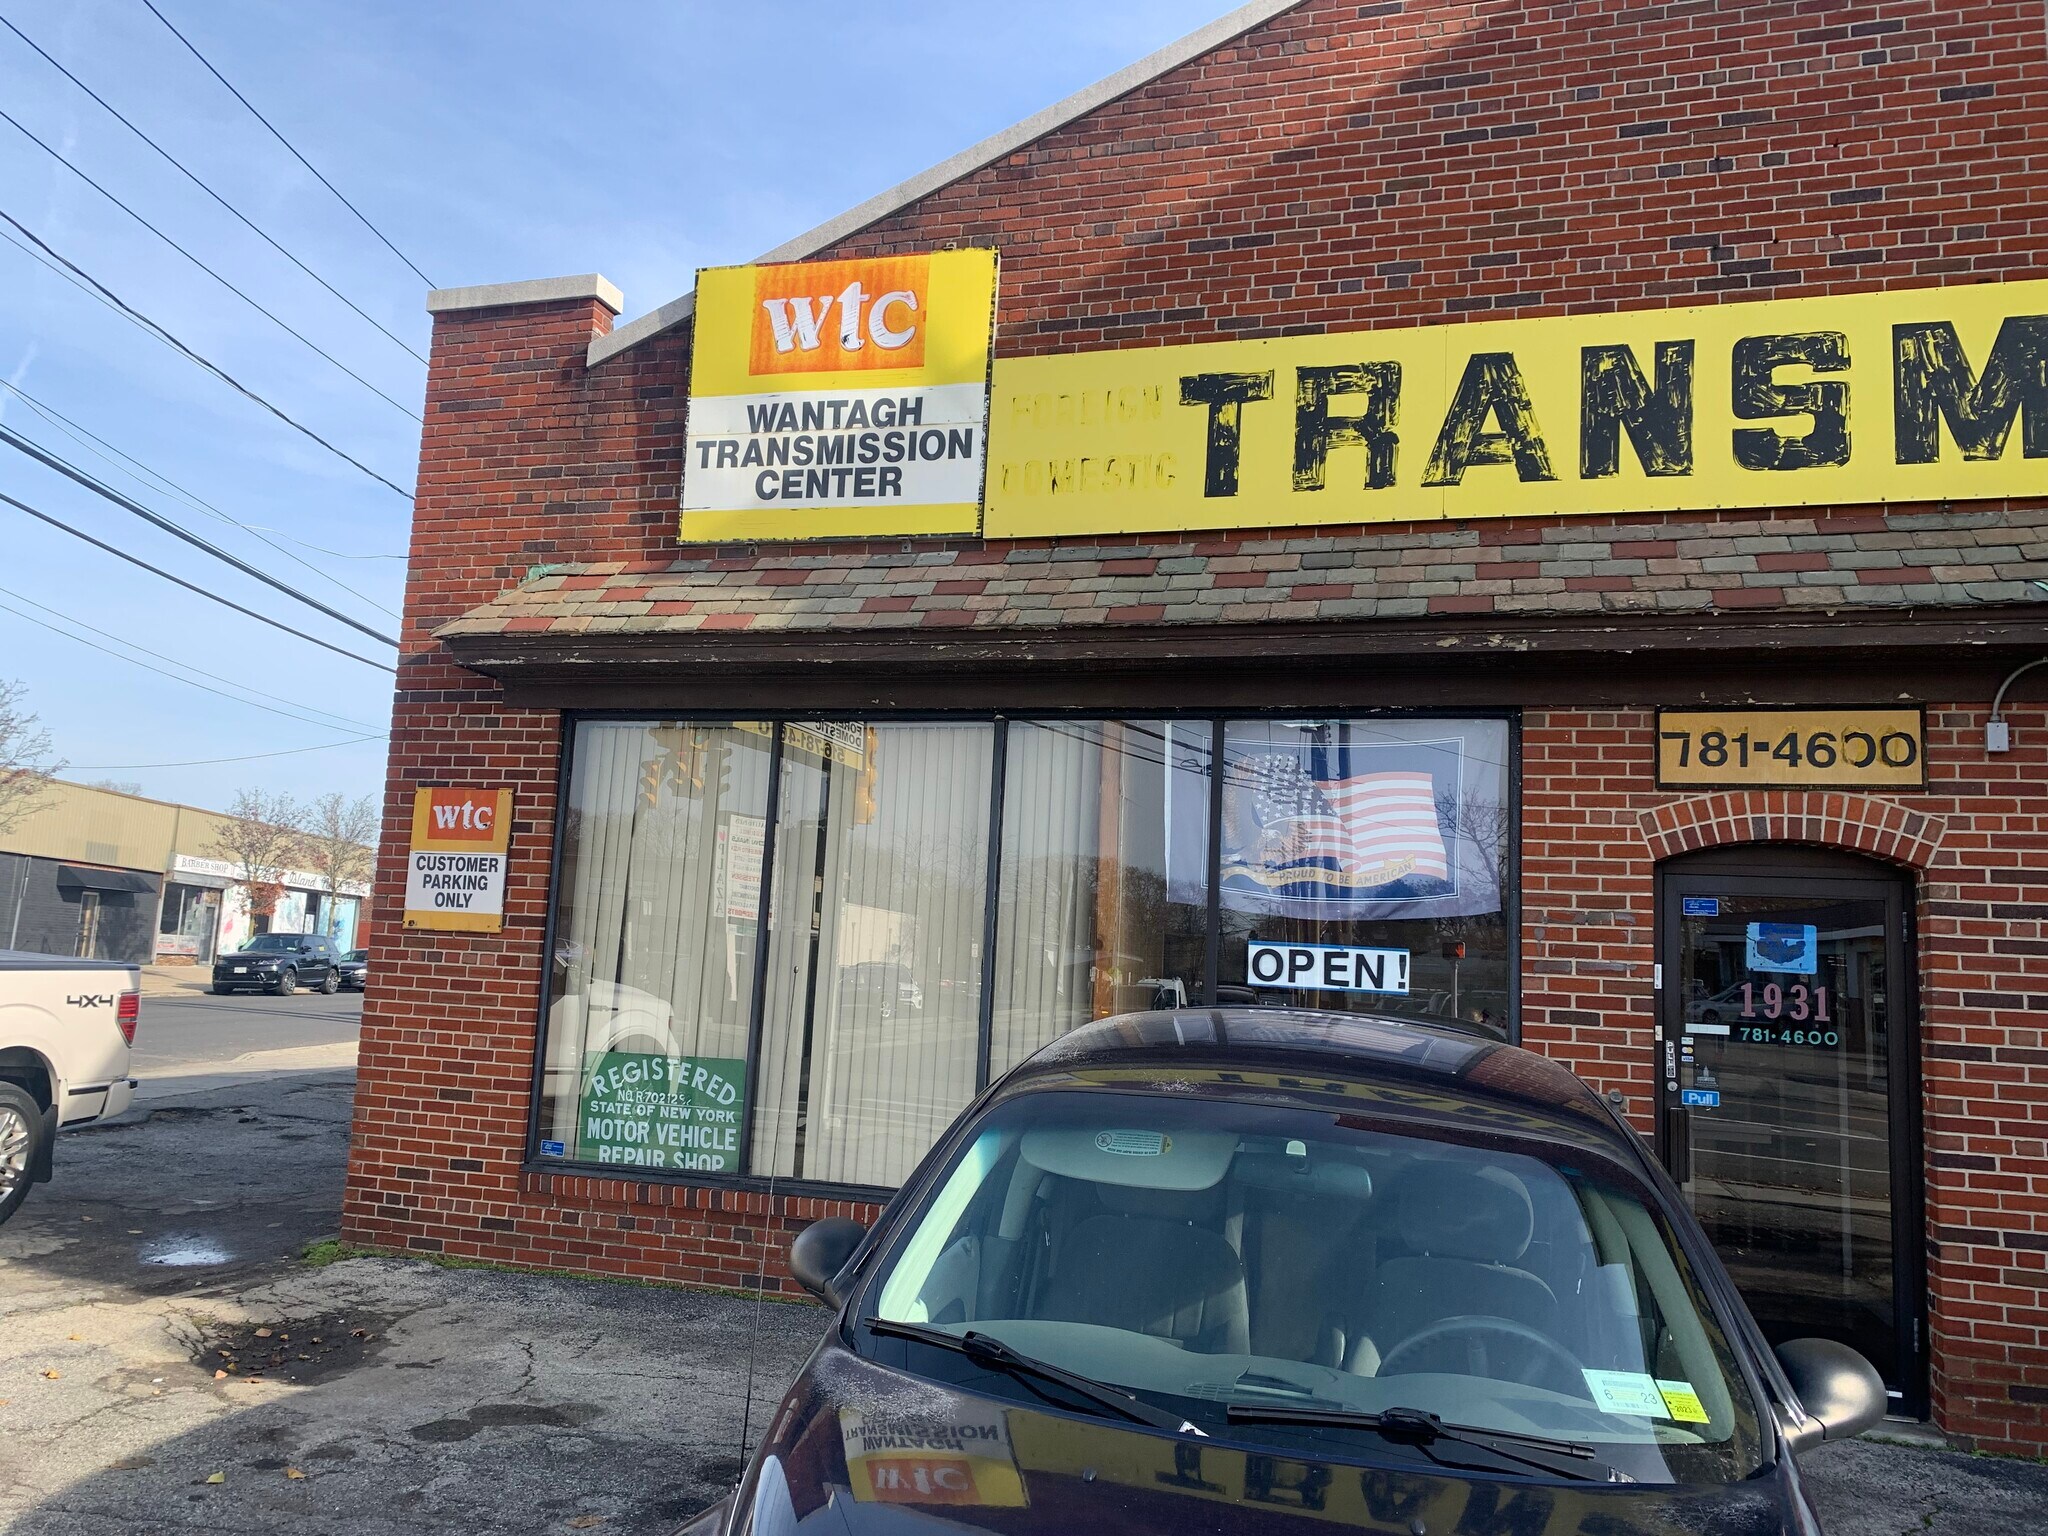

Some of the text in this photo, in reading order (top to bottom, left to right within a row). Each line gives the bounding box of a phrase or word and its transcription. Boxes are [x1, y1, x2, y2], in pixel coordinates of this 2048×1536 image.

[762, 281, 919, 354] wtc
[747, 397, 923, 433] WANTAGH
[696, 428, 973, 470] TRANSMISSION
[755, 466, 902, 501] CENTER
[1661, 731, 1917, 769] 781-4600
[433, 800, 493, 830] wtc
[182, 857, 209, 870] BARBER
[210, 862, 229, 873] SHOP
[416, 856, 498, 872] CUSTOMER
[1279, 861, 1412, 885] PROUD TO BE AMERICAN
[423, 874, 488, 890] PARKING
[435, 892, 472, 908] ONLY
[1252, 948, 1407, 990] OPEN!
[66, 994, 113, 1008] 4X4
[1740, 982, 1830, 1022] 1931
[592, 1057, 736, 1105] REGISTERED
[1689, 1092, 1713, 1105] Pull
[590, 1101, 736, 1123] STATE OF NEW YORK
[587, 1117, 737, 1150] MOTOR VEHICLE
[599, 1145, 725, 1171] REPAIR SHOP
[1604, 1389, 1613, 1400] 6
[1640, 1393, 1657, 1404] 23
[1675, 1405, 1692, 1413] 2023
